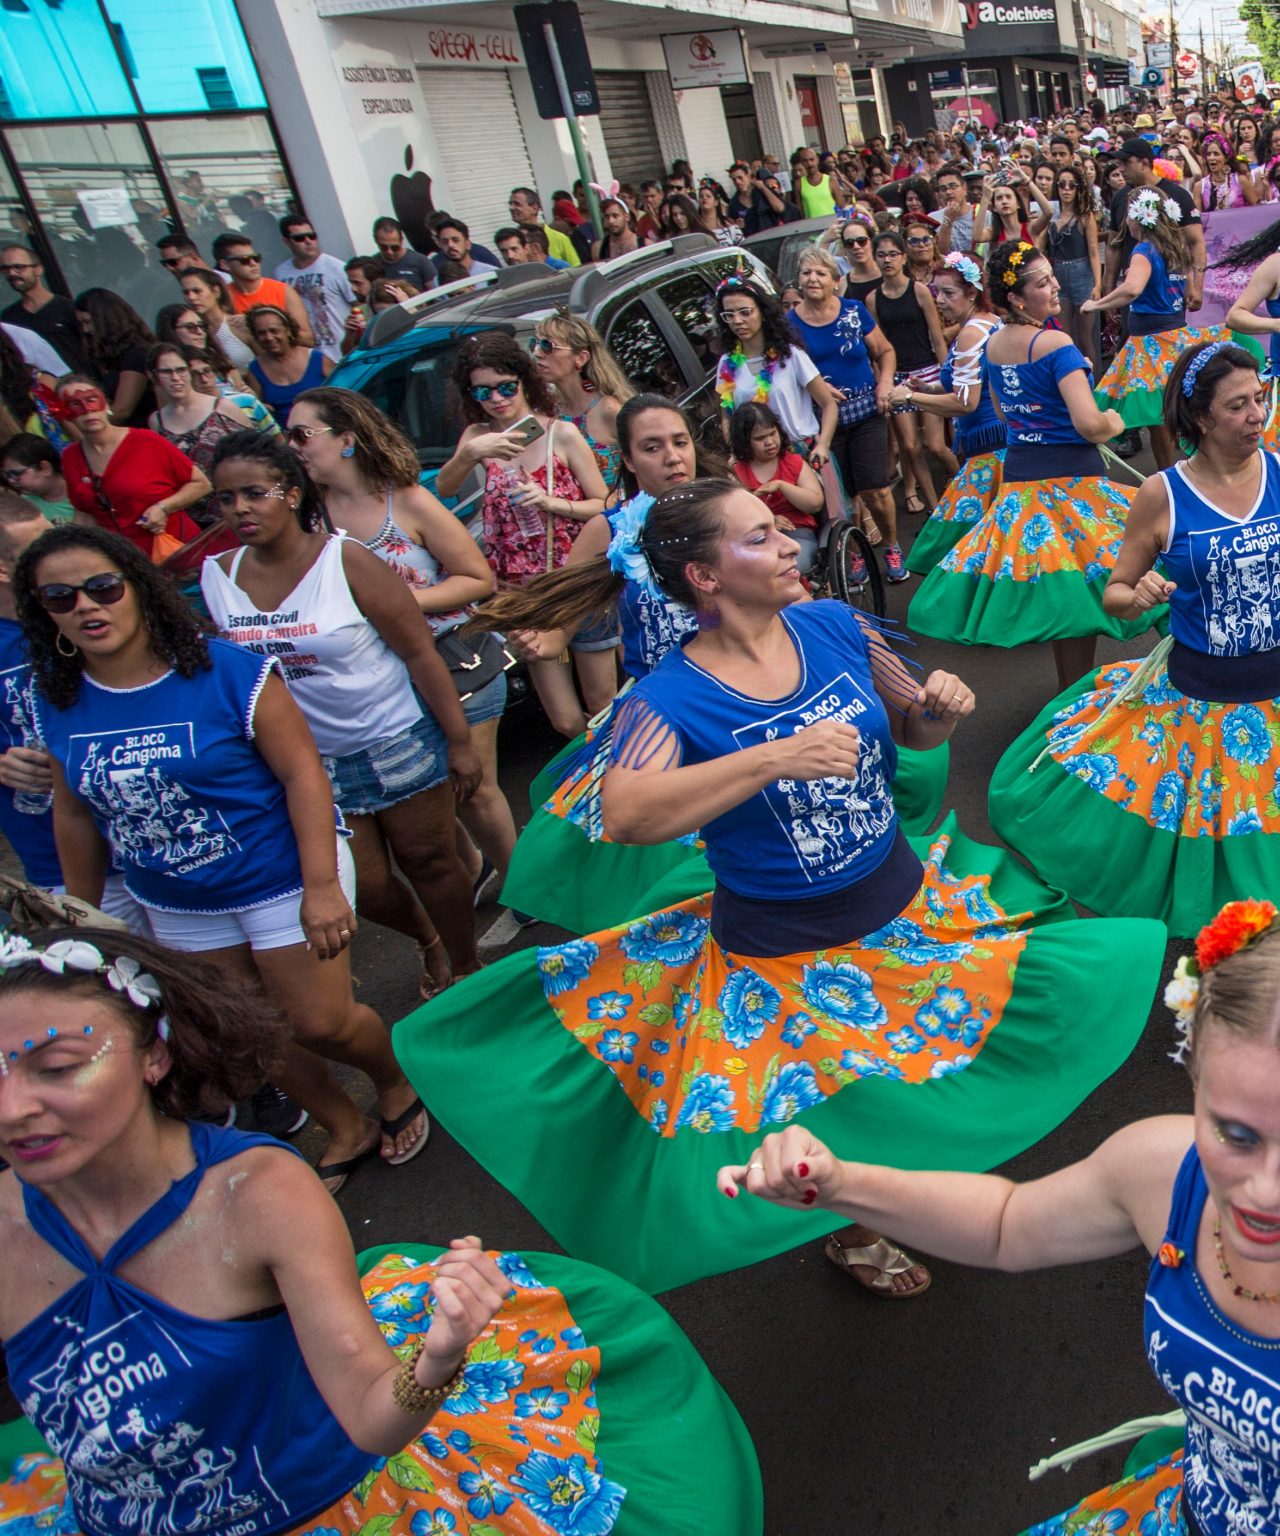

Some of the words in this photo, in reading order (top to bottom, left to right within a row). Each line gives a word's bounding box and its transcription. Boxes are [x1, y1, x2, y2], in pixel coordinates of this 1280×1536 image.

[996, 6, 1054, 22] Colchões
[1240, 522, 1278, 540] BLOCO
[271, 610, 299, 624] Civil
[266, 623, 318, 640] carreira
[266, 641, 296, 655] com
[799, 694, 841, 727] BLOCO
[125, 732, 165, 749] BLOCO
[112, 744, 181, 766] Cangoma
[178, 851, 225, 874] CHAMANDO
